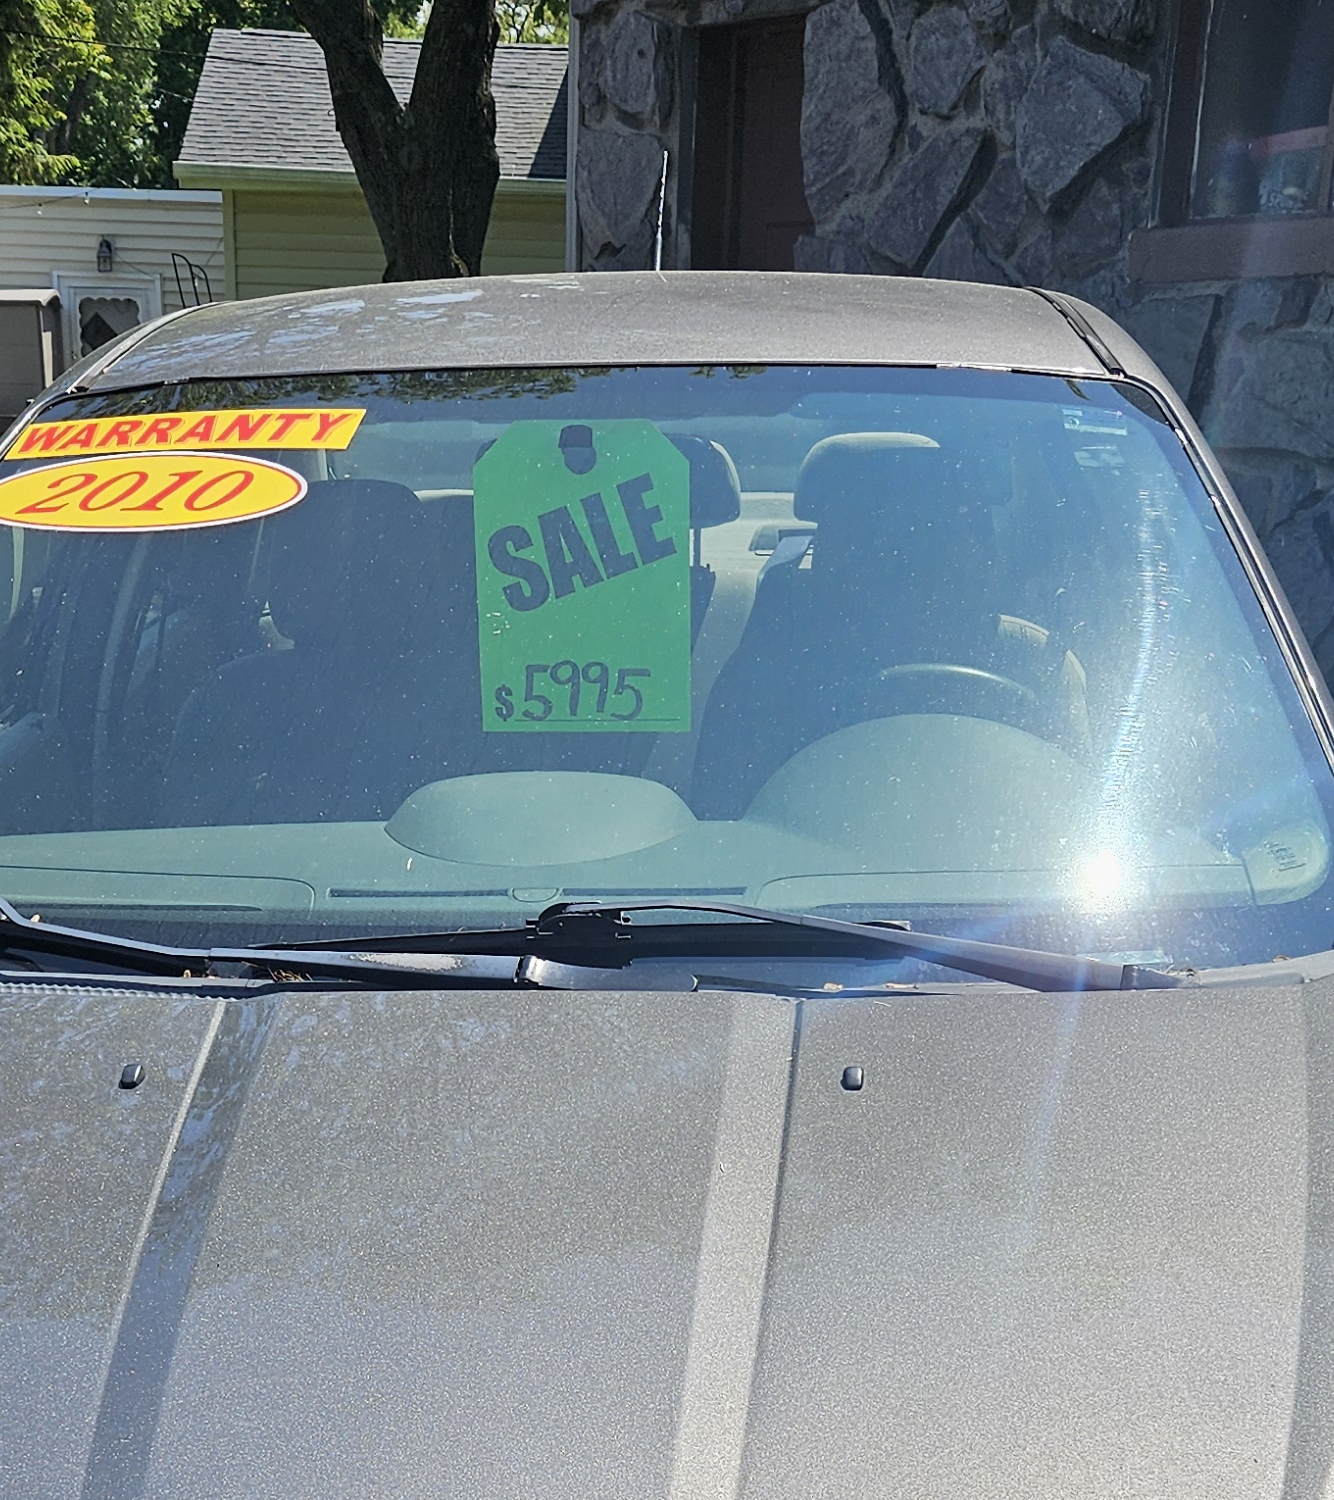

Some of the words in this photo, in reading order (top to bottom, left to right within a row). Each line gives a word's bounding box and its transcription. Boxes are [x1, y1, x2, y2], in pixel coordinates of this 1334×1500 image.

[18, 413, 360, 455] WARRANTY
[15, 470, 255, 516] 2010
[488, 472, 677, 612] SALE
[494, 660, 652, 722] $5995
